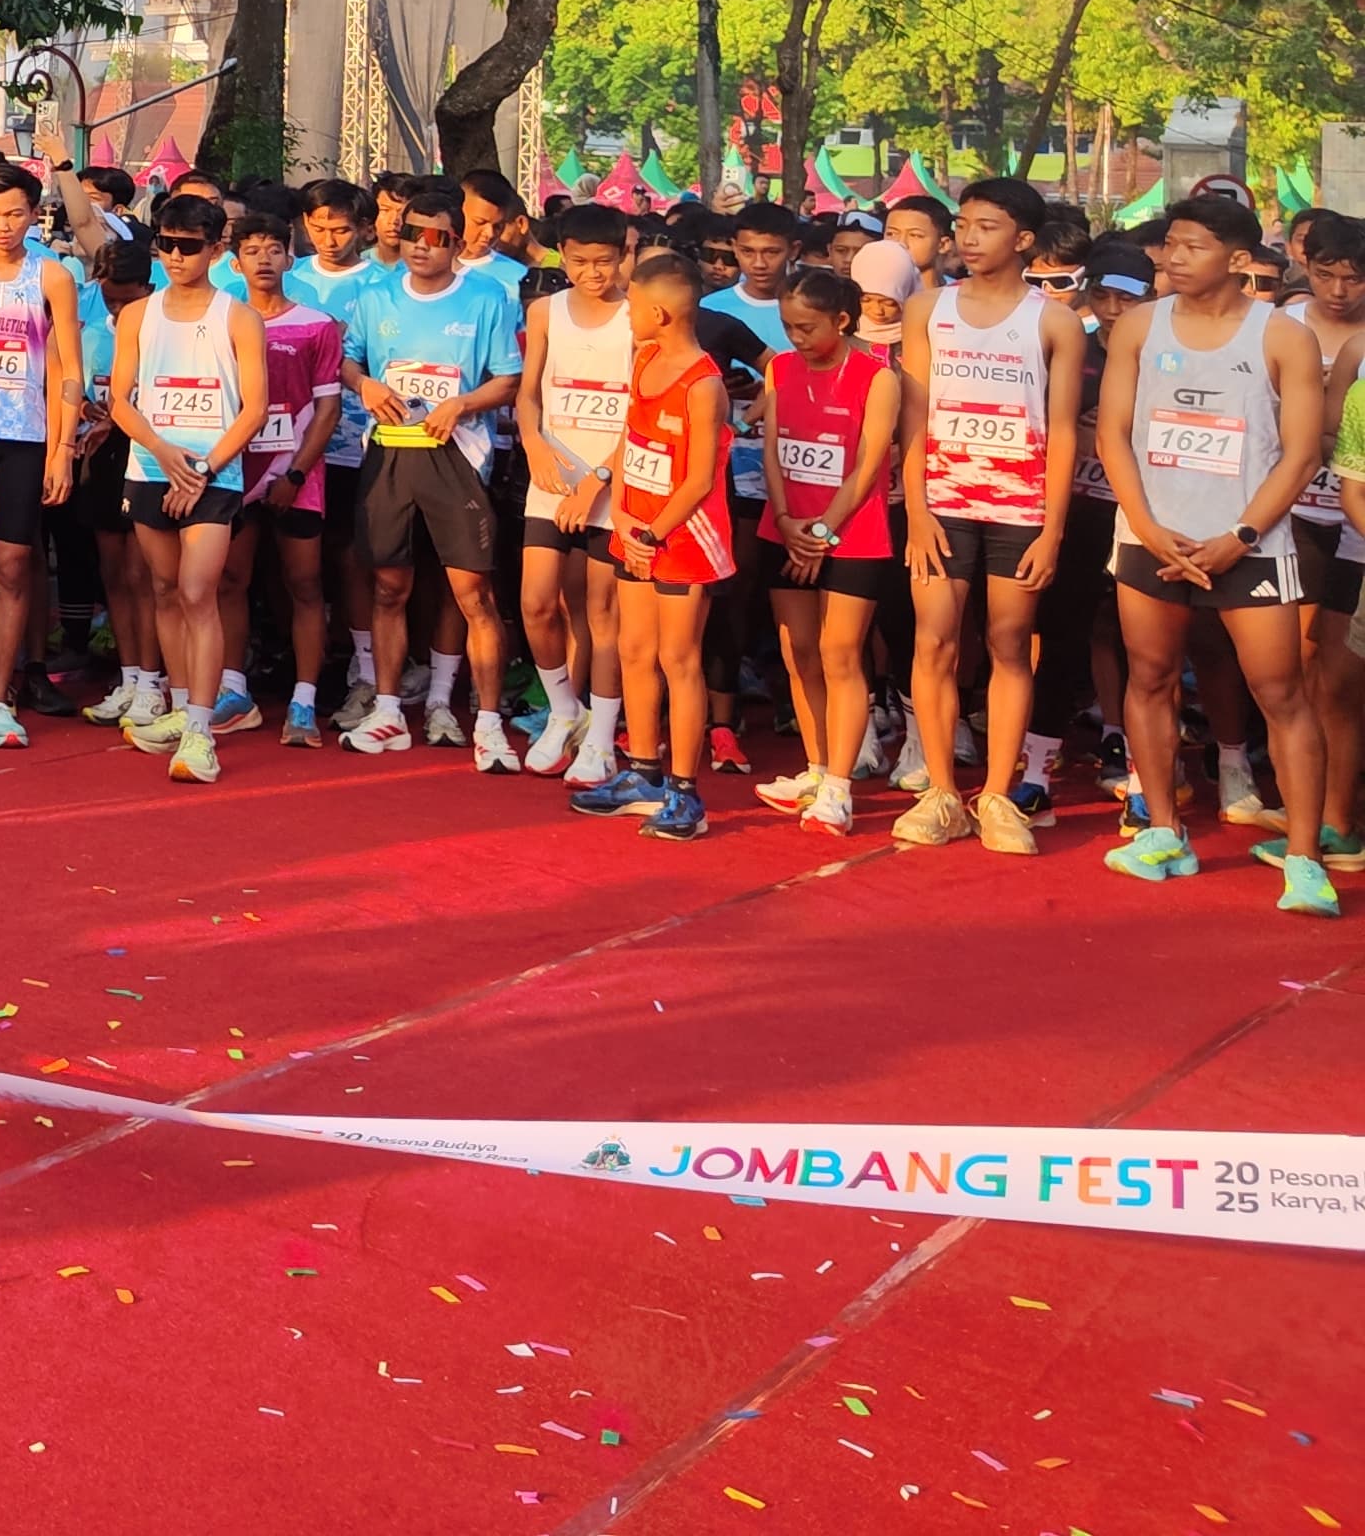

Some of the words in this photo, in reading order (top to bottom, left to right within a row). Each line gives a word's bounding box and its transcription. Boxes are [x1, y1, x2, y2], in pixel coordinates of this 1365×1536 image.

[937, 348, 959, 358] THE
[961, 350, 1023, 364] RUNNERS
[933, 362, 1035, 386] NDONESIA
[396, 376, 450, 399] 1586
[1174, 388, 1225, 406] GT
[160, 391, 213, 413] 1245
[561, 393, 619, 416] 1728
[947, 416, 1017, 442] 1395
[1161, 427, 1231, 456] 1621
[626, 448, 659, 477] 041
[782, 443, 833, 470] 1362
[1151, 454, 1174, 464] 5KM
[367, 1135, 428, 1149] Pesona
[432, 1139, 498, 1154] Budaya
[649, 1145, 1008, 1198] JOMBANG
[1038, 1155, 1199, 1209] FEST
[1214, 1161, 1260, 1185] 20
[1270, 1168, 1358, 1188] Pesona
[1215, 1191, 1259, 1213] 25
[1271, 1192, 1347, 1214] Karya,
